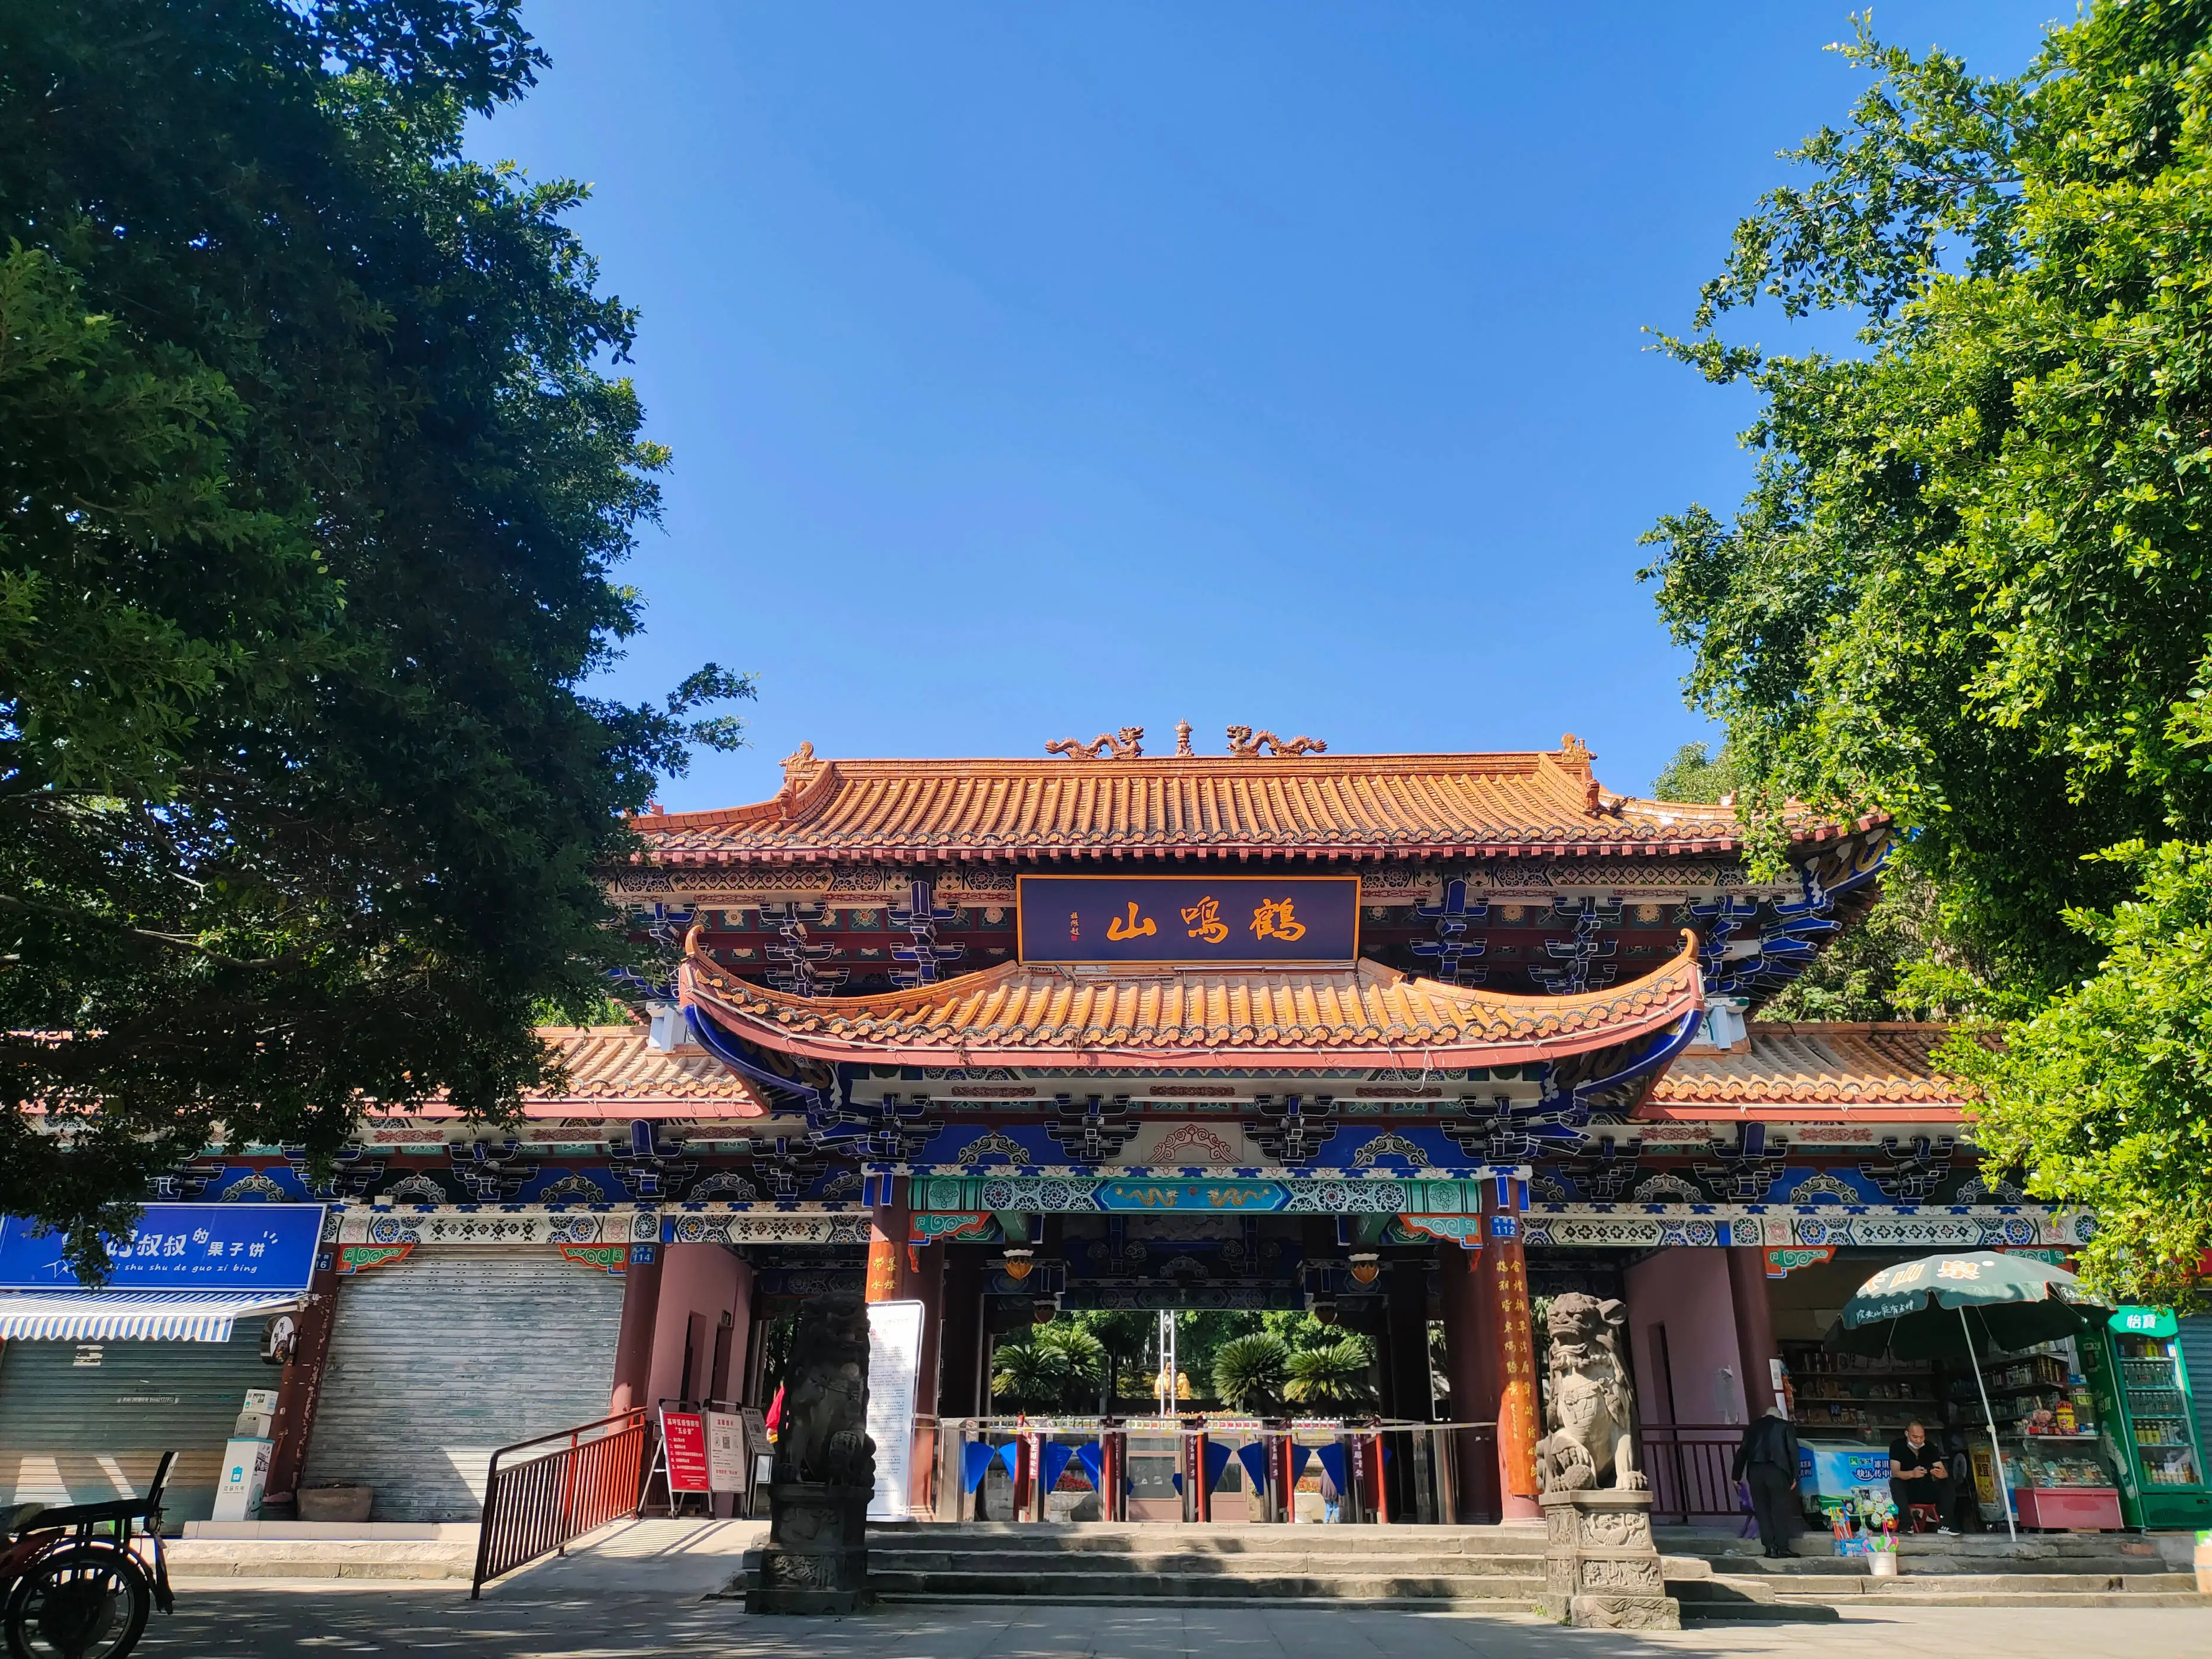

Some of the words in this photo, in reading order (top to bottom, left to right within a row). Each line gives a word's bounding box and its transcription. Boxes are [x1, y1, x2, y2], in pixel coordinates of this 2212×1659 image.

[1496, 1225, 1516, 1235] 112
[633, 1254, 650, 1262] 114
[148, 1263, 168, 1271] shu
[173, 1263, 188, 1271] de
[191, 1265, 213, 1273] guo
[232, 1263, 258, 1274] bing
